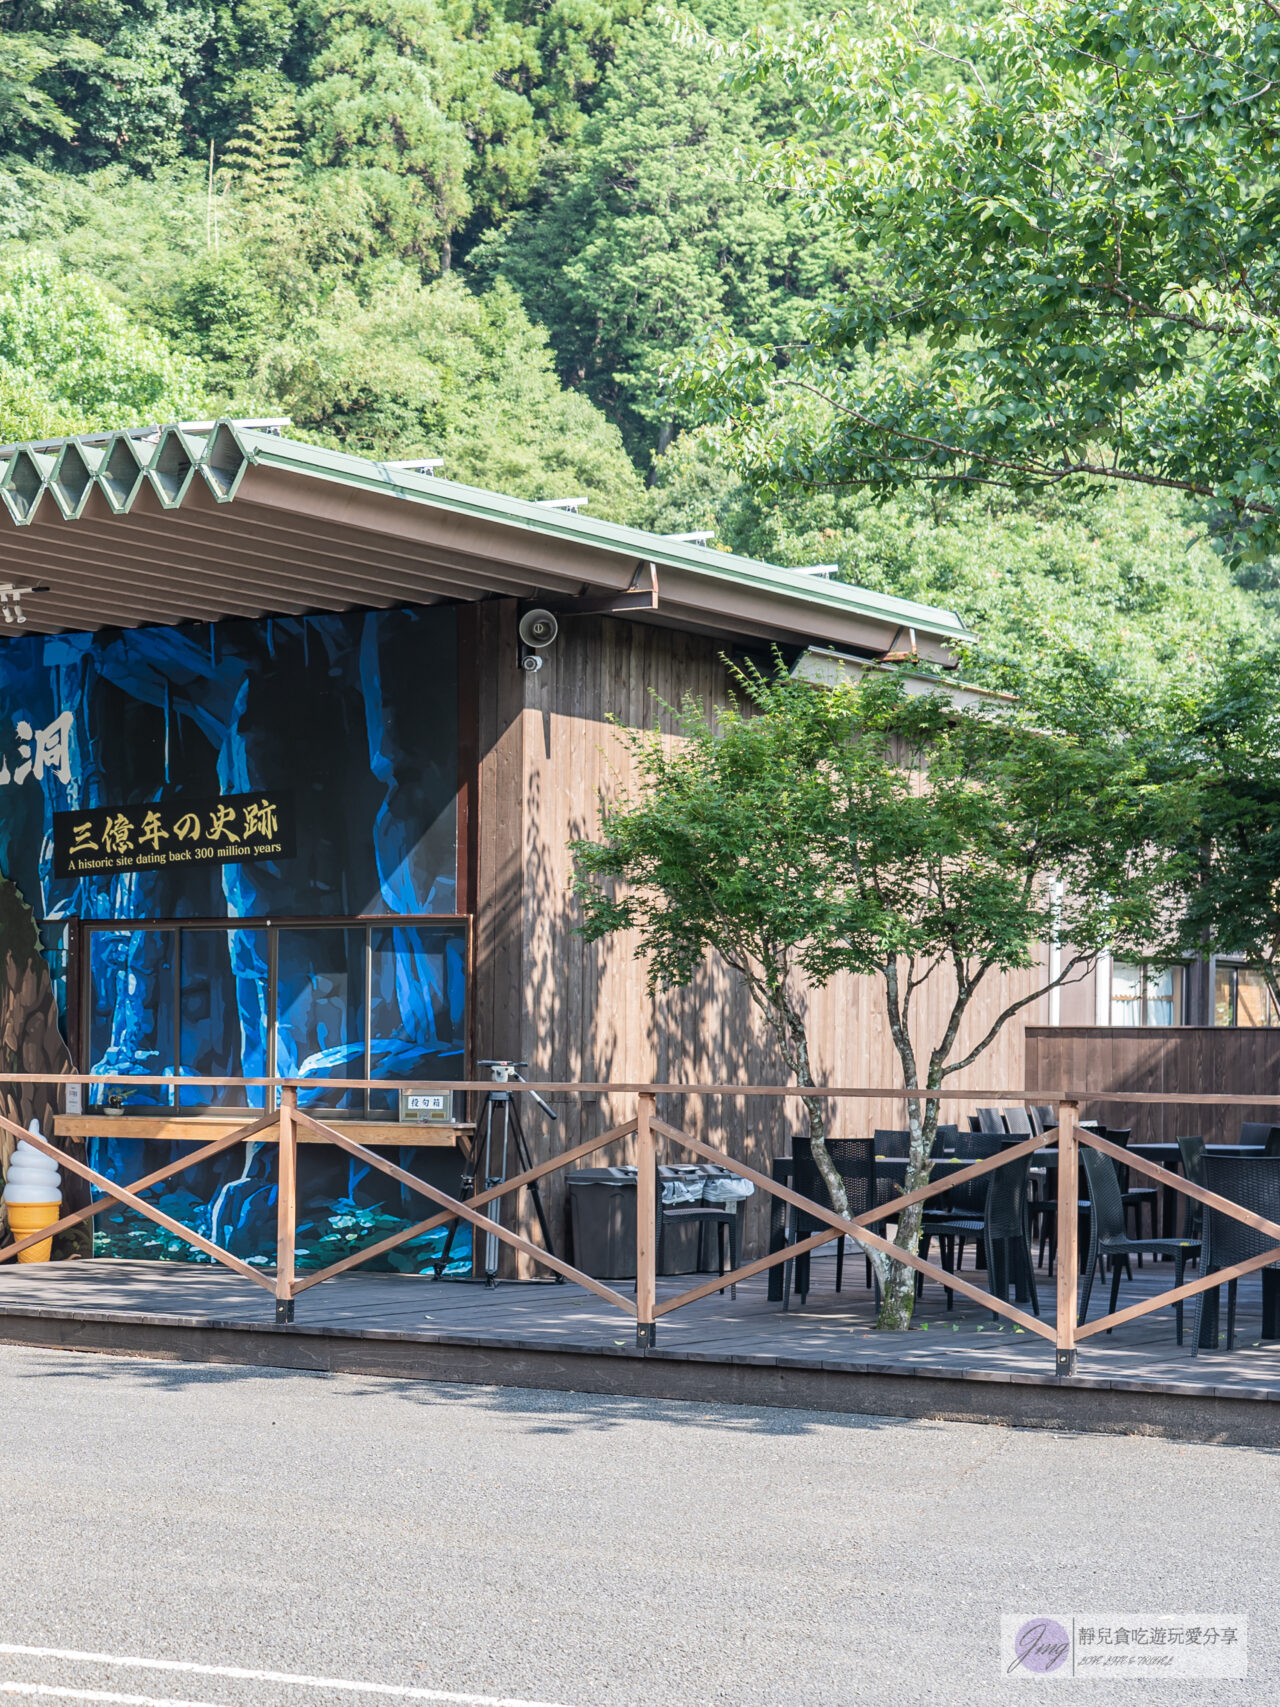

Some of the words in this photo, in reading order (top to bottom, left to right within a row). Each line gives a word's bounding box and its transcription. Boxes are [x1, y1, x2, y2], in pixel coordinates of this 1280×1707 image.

[68, 799, 279, 854] 三億年の史跡
[68, 860, 76, 870] A
[78, 856, 114, 869] historic
[116, 855, 133, 866] site
[136, 852, 166, 864] dating
[168, 849, 192, 861] back
[194, 847, 214, 859] 300
[217, 845, 251, 857] million
[253, 843, 282, 856] years
